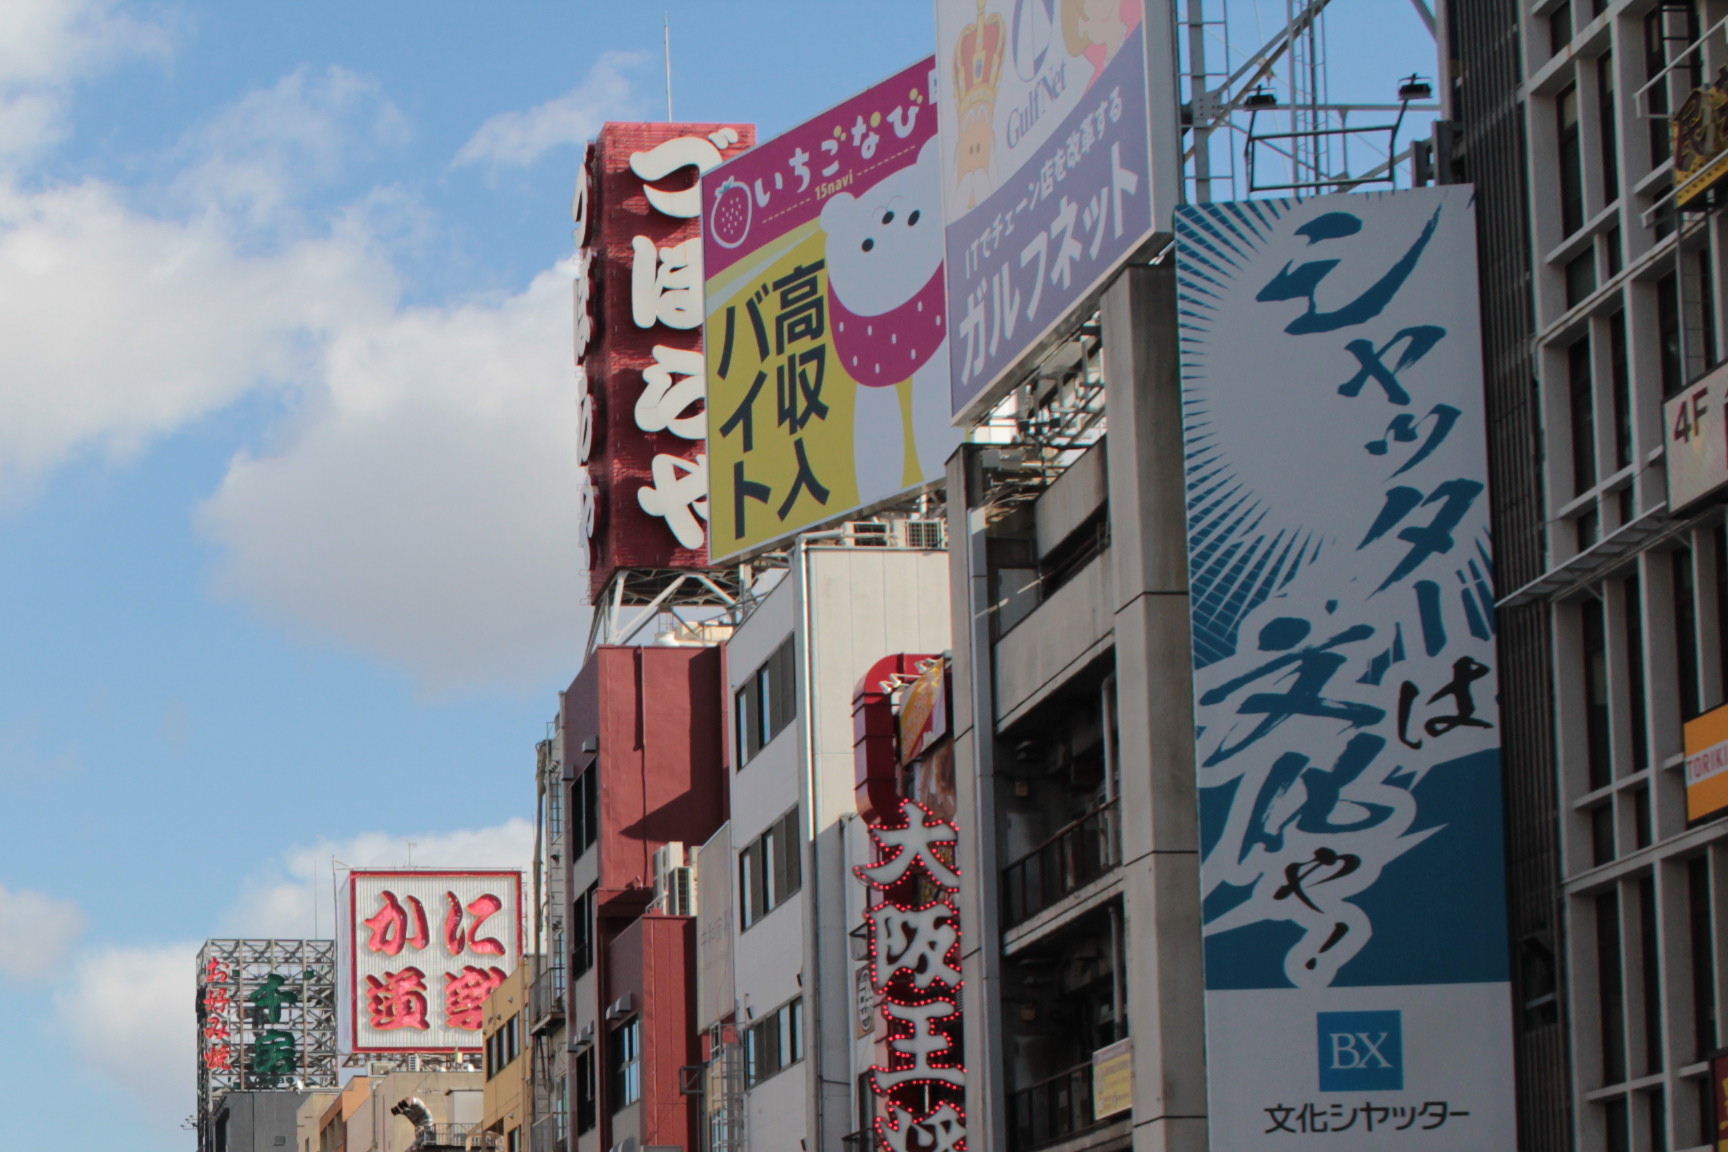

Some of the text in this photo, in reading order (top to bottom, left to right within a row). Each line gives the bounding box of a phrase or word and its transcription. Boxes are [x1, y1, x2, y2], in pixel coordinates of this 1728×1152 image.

[754, 88, 923, 207] いちごなび
[814, 168, 854, 200] 15navi
[964, 84, 1122, 280] ITでチェーン店を改革する
[959, 140, 1139, 387] ガルフネット
[717, 282, 772, 541] バイト
[771, 256, 830, 522] 高収入
[1673, 386, 1708, 445] 4F
[1256, 202, 1494, 750] シャッターは
[363, 889, 506, 957] かに
[204, 957, 233, 1070] お好み焼
[251, 972, 298, 1075] 千房
[1329, 1031, 1392, 1070] BX
